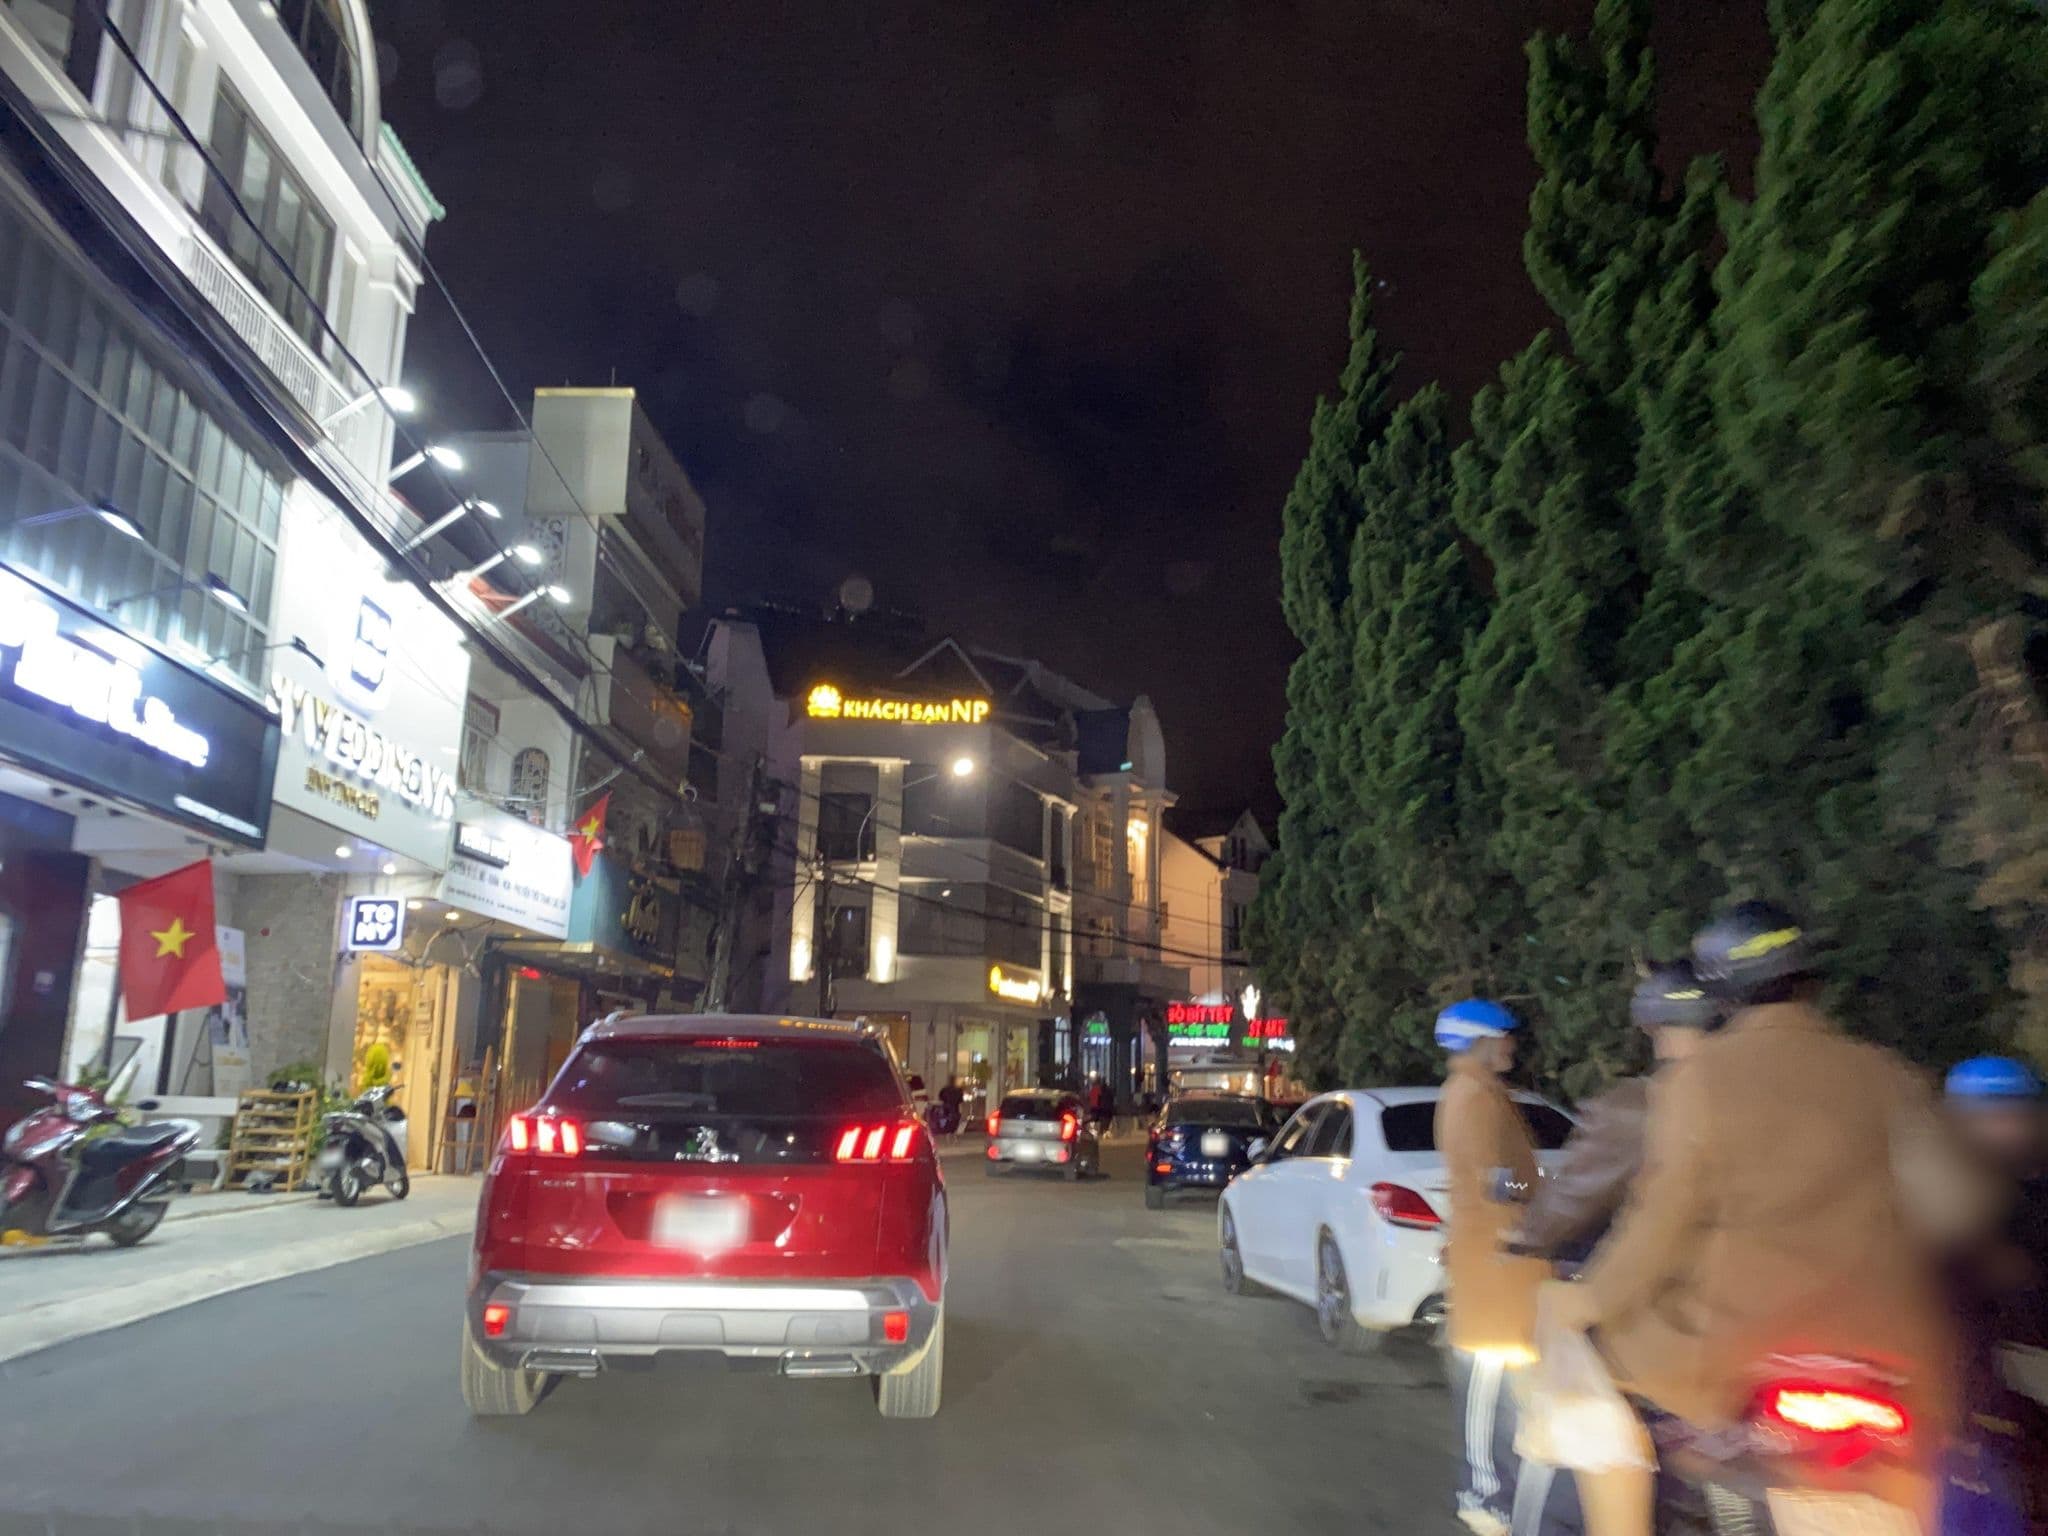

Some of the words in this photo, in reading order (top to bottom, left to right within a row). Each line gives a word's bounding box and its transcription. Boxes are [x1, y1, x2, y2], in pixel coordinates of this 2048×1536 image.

[843, 699, 908, 719] KHÁCH
[911, 703, 949, 724] SẠN
[951, 699, 989, 723] NP
[358, 903, 395, 923] TO
